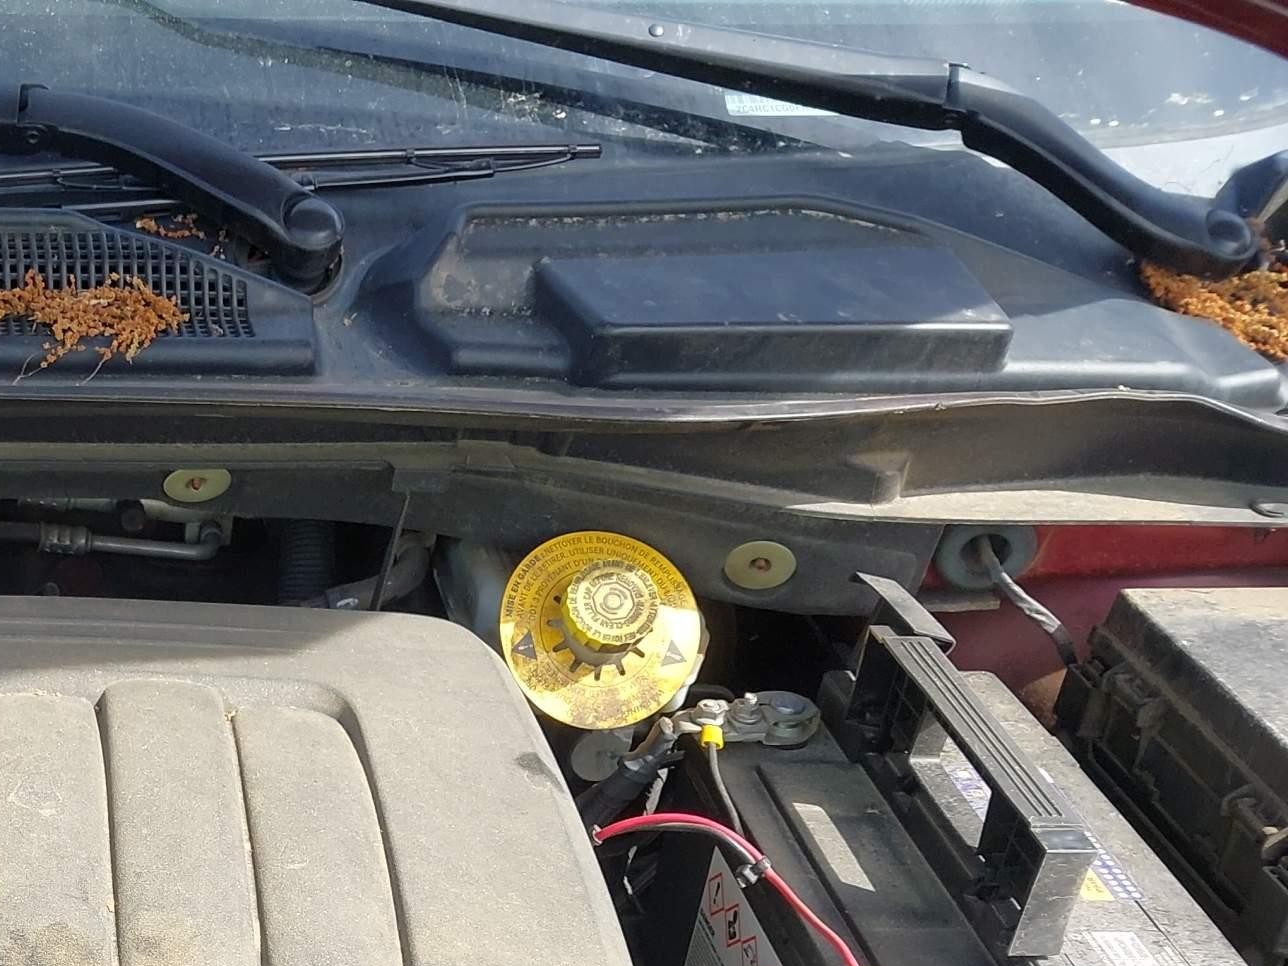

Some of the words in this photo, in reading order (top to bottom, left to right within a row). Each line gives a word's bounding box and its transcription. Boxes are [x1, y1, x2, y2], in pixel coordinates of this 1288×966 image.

[584, 536, 594, 544] LE
[596, 536, 639, 553] BOUCHON
[639, 549, 650, 560] DE
[517, 555, 541, 580] GARDE
[511, 582, 521, 595] EN
[505, 594, 518, 617] MISE
